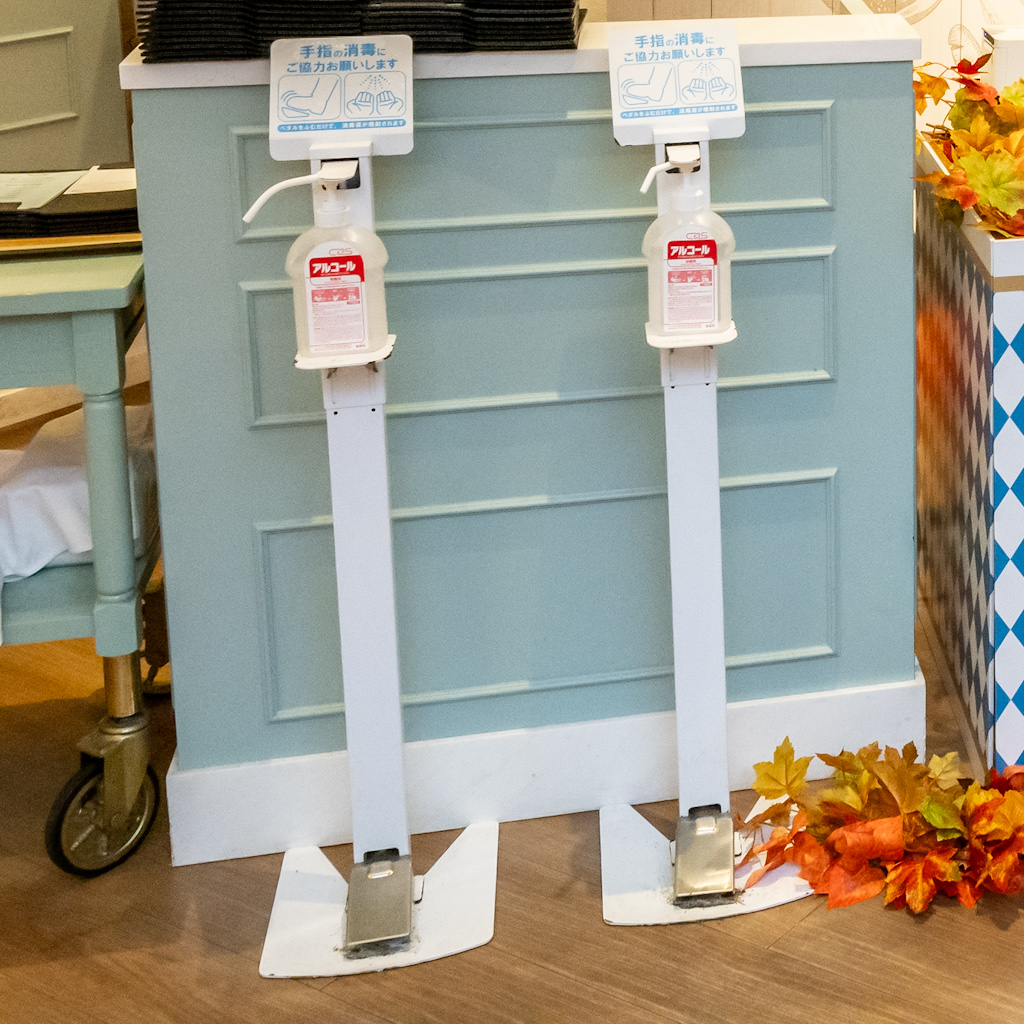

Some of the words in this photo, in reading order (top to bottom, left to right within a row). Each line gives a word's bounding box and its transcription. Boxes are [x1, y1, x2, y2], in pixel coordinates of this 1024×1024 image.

[634, 32, 714, 49] 手指の消毒に
[299, 42, 386, 59] 手指の消毒に
[623, 47, 726, 63] ご協力お願いします
[286, 58, 399, 73] ご協力お願いします
[670, 245, 711, 256] アルコール
[312, 261, 356, 274] アルコール
